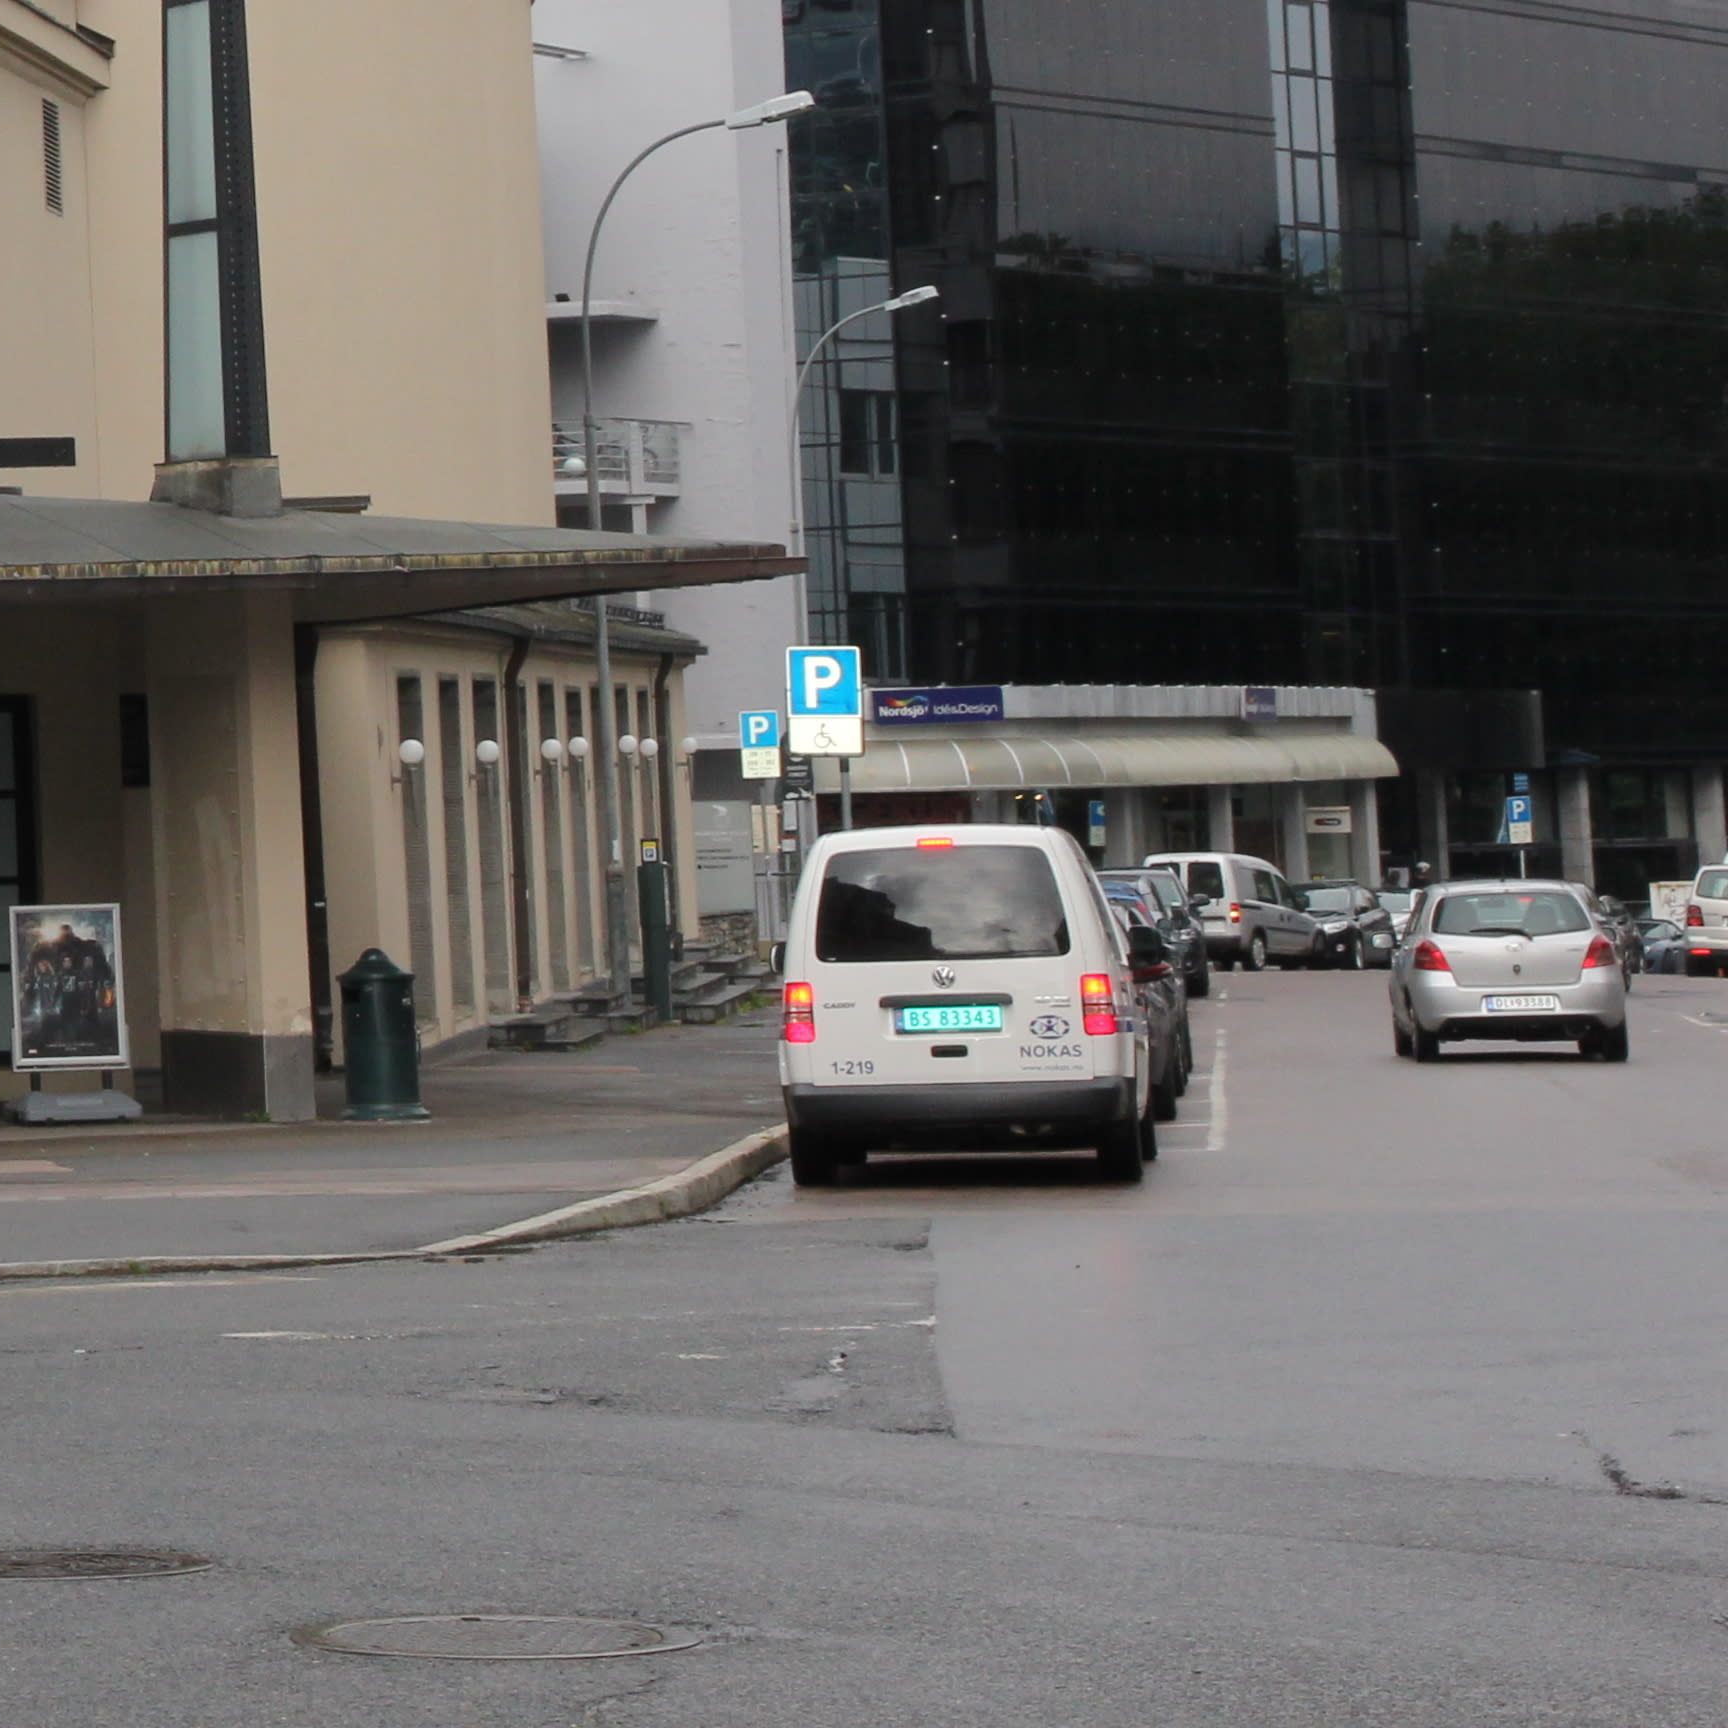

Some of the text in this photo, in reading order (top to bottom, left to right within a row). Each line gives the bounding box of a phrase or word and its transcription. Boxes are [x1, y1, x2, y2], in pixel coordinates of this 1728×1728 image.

[804, 656, 842, 709] P
[748, 716, 770, 745] P
[1512, 800, 1525, 820] P
[910, 1009, 994, 1026] BS 83343
[1020, 1044, 1082, 1058] NOKAS
[831, 1060, 874, 1075] 1-219
